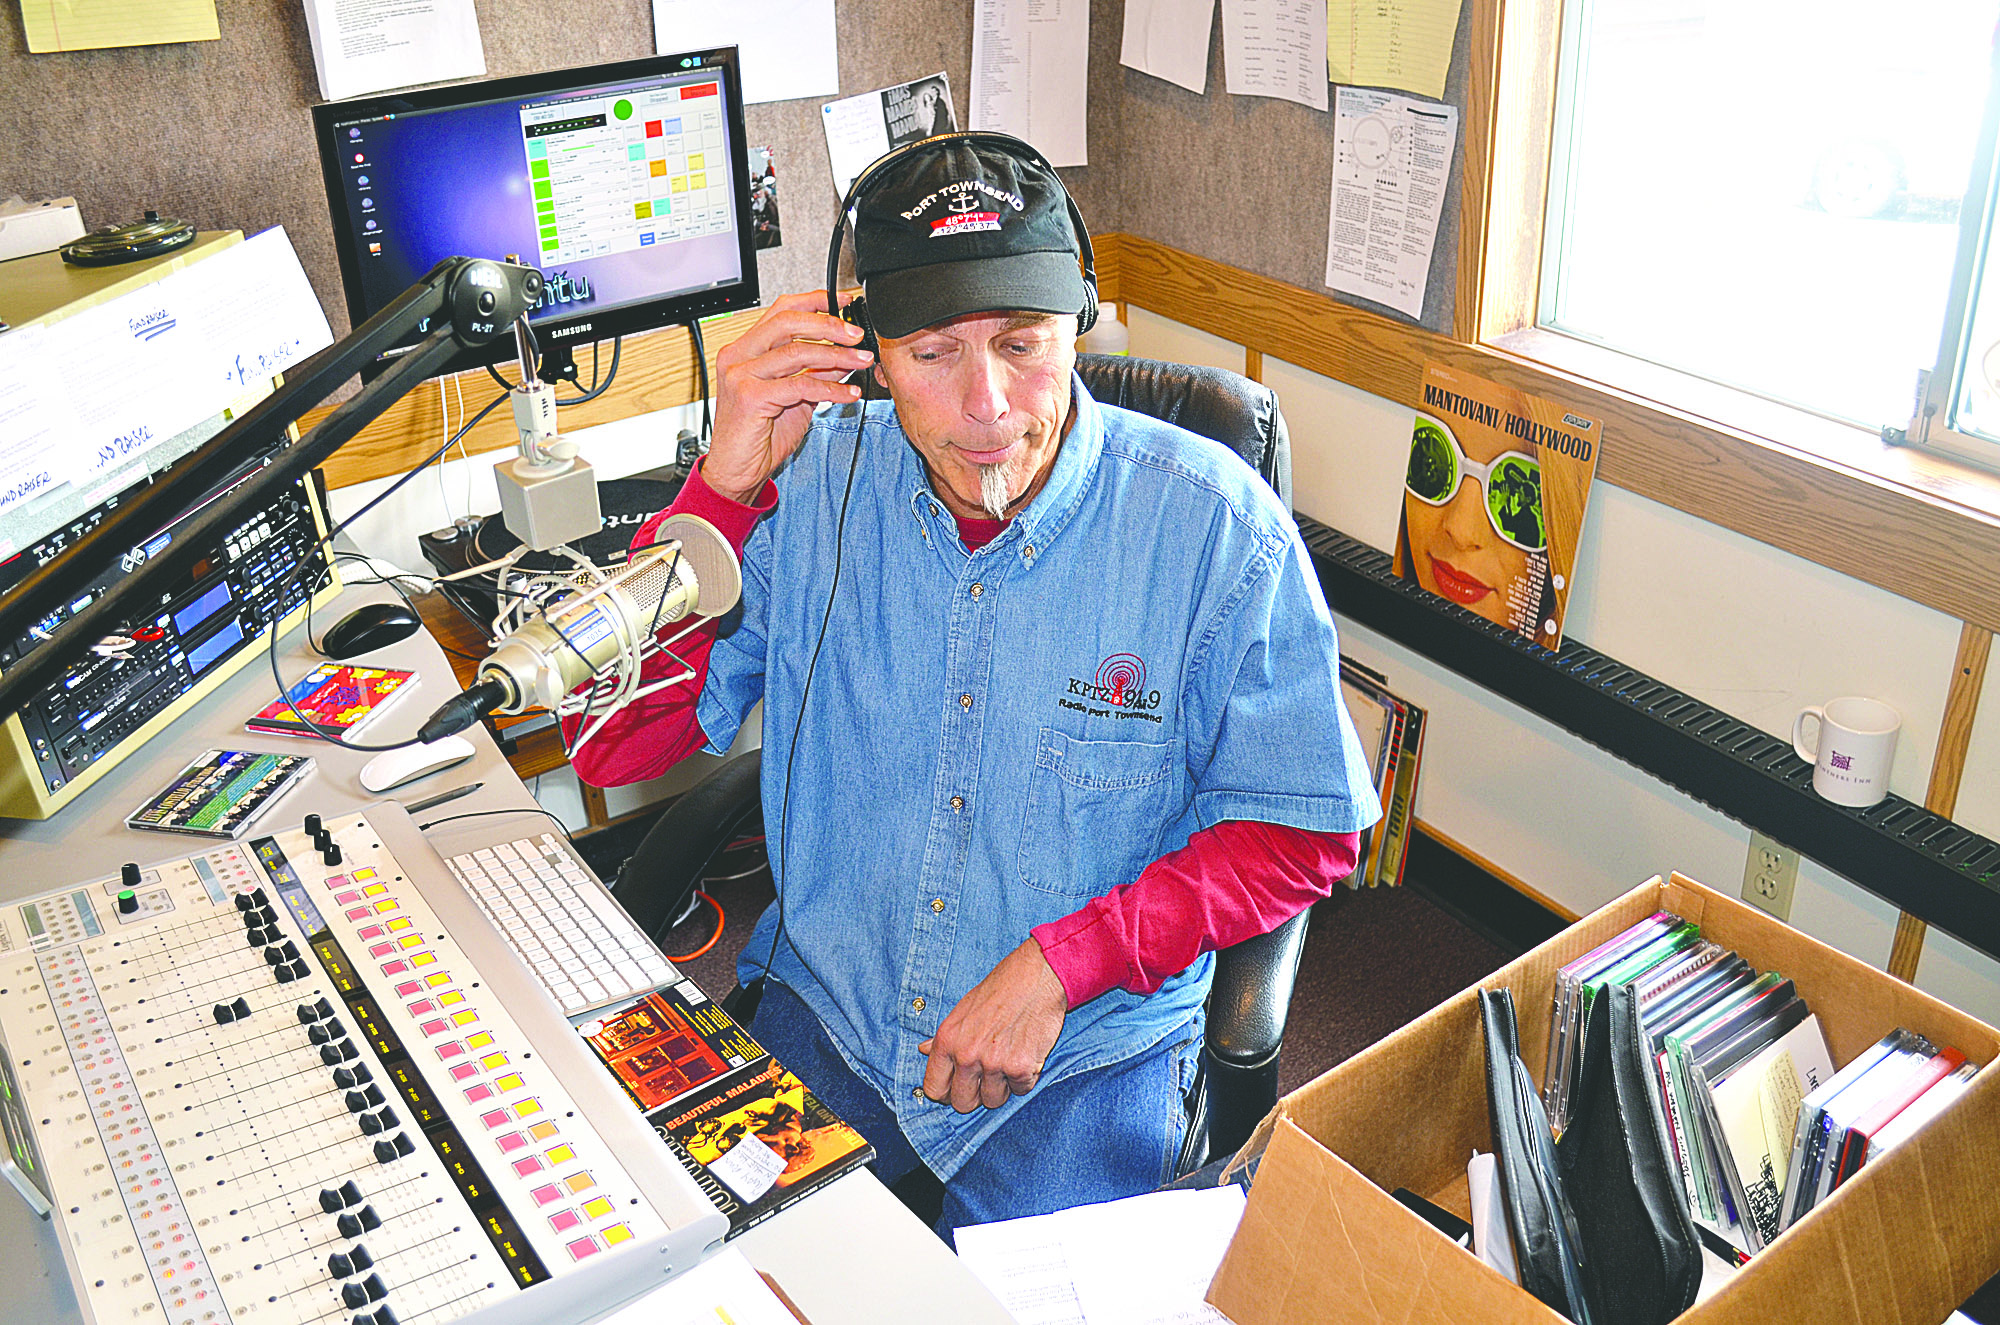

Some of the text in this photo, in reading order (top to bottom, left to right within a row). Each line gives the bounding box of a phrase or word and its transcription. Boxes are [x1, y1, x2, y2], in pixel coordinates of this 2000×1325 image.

[901, 180, 1025, 220] PORT TOWNSEND
[552, 323, 593, 339] SAMSUNG
[1067, 677, 1111, 702] KPTZ
[1058, 699, 1087, 713] Radio
[1114, 711, 1163, 723] Townsend
[665, 1066, 784, 1131] BEAUTIFUL MALADIES
[1669, 1093, 1682, 1131] WOMEN
